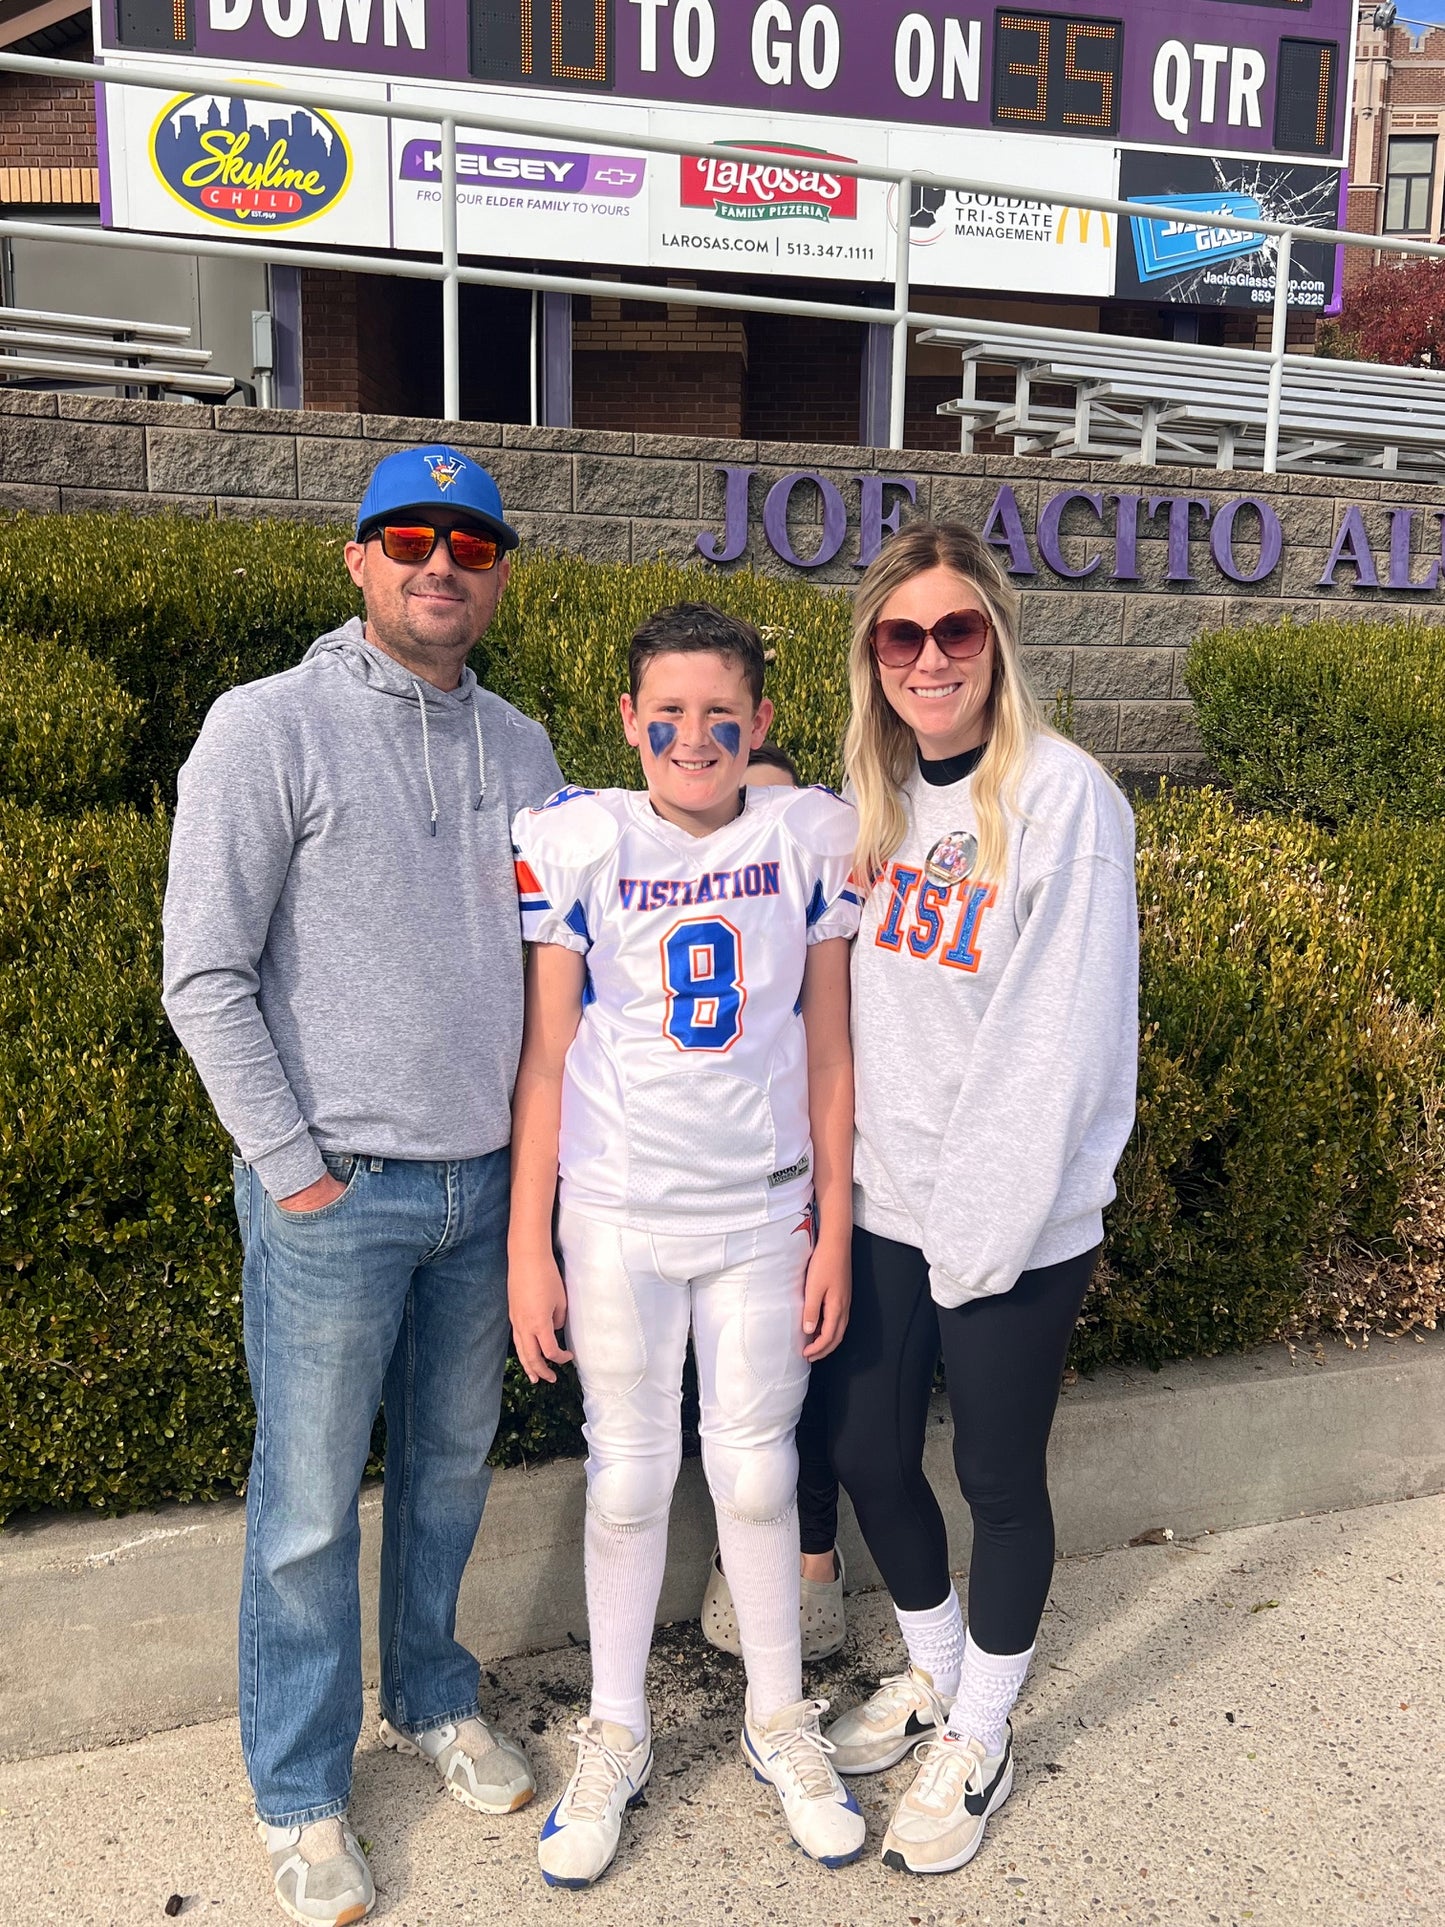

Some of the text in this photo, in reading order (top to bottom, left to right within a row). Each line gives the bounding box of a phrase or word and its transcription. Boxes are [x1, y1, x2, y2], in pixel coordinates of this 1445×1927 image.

[628, 0, 982, 102] TO GO ON
[998, 16, 1116, 127] 35
[1152, 39, 1267, 134] QTR
[1315, 48, 1331, 146] 1
[182, 129, 326, 219] Skyline
[423, 150, 575, 183] KELSEY
[209, 190, 293, 208] CHILI
[416, 189, 442, 202] FRO
[486, 195, 524, 209] ELDER
[527, 199, 570, 212] FAMILY
[572, 202, 588, 214] TO
[591, 204, 631, 217] YOURS
[721, 204, 823, 219] FAMILY PIZZERIA
[955, 207, 1053, 228] TRI-STATE
[661, 233, 874, 261] LAROSAS.COM 513.347.1111
[954, 224, 1052, 243] MANAGEMENT
[1202, 271, 1326, 292] JacksGlassSp.com
[1250, 289, 1325, 306] 859-2-5225
[981, 485, 1284, 583] ACITO
[1315, 505, 1445, 590] AL
[659, 915, 747, 1054] 8
